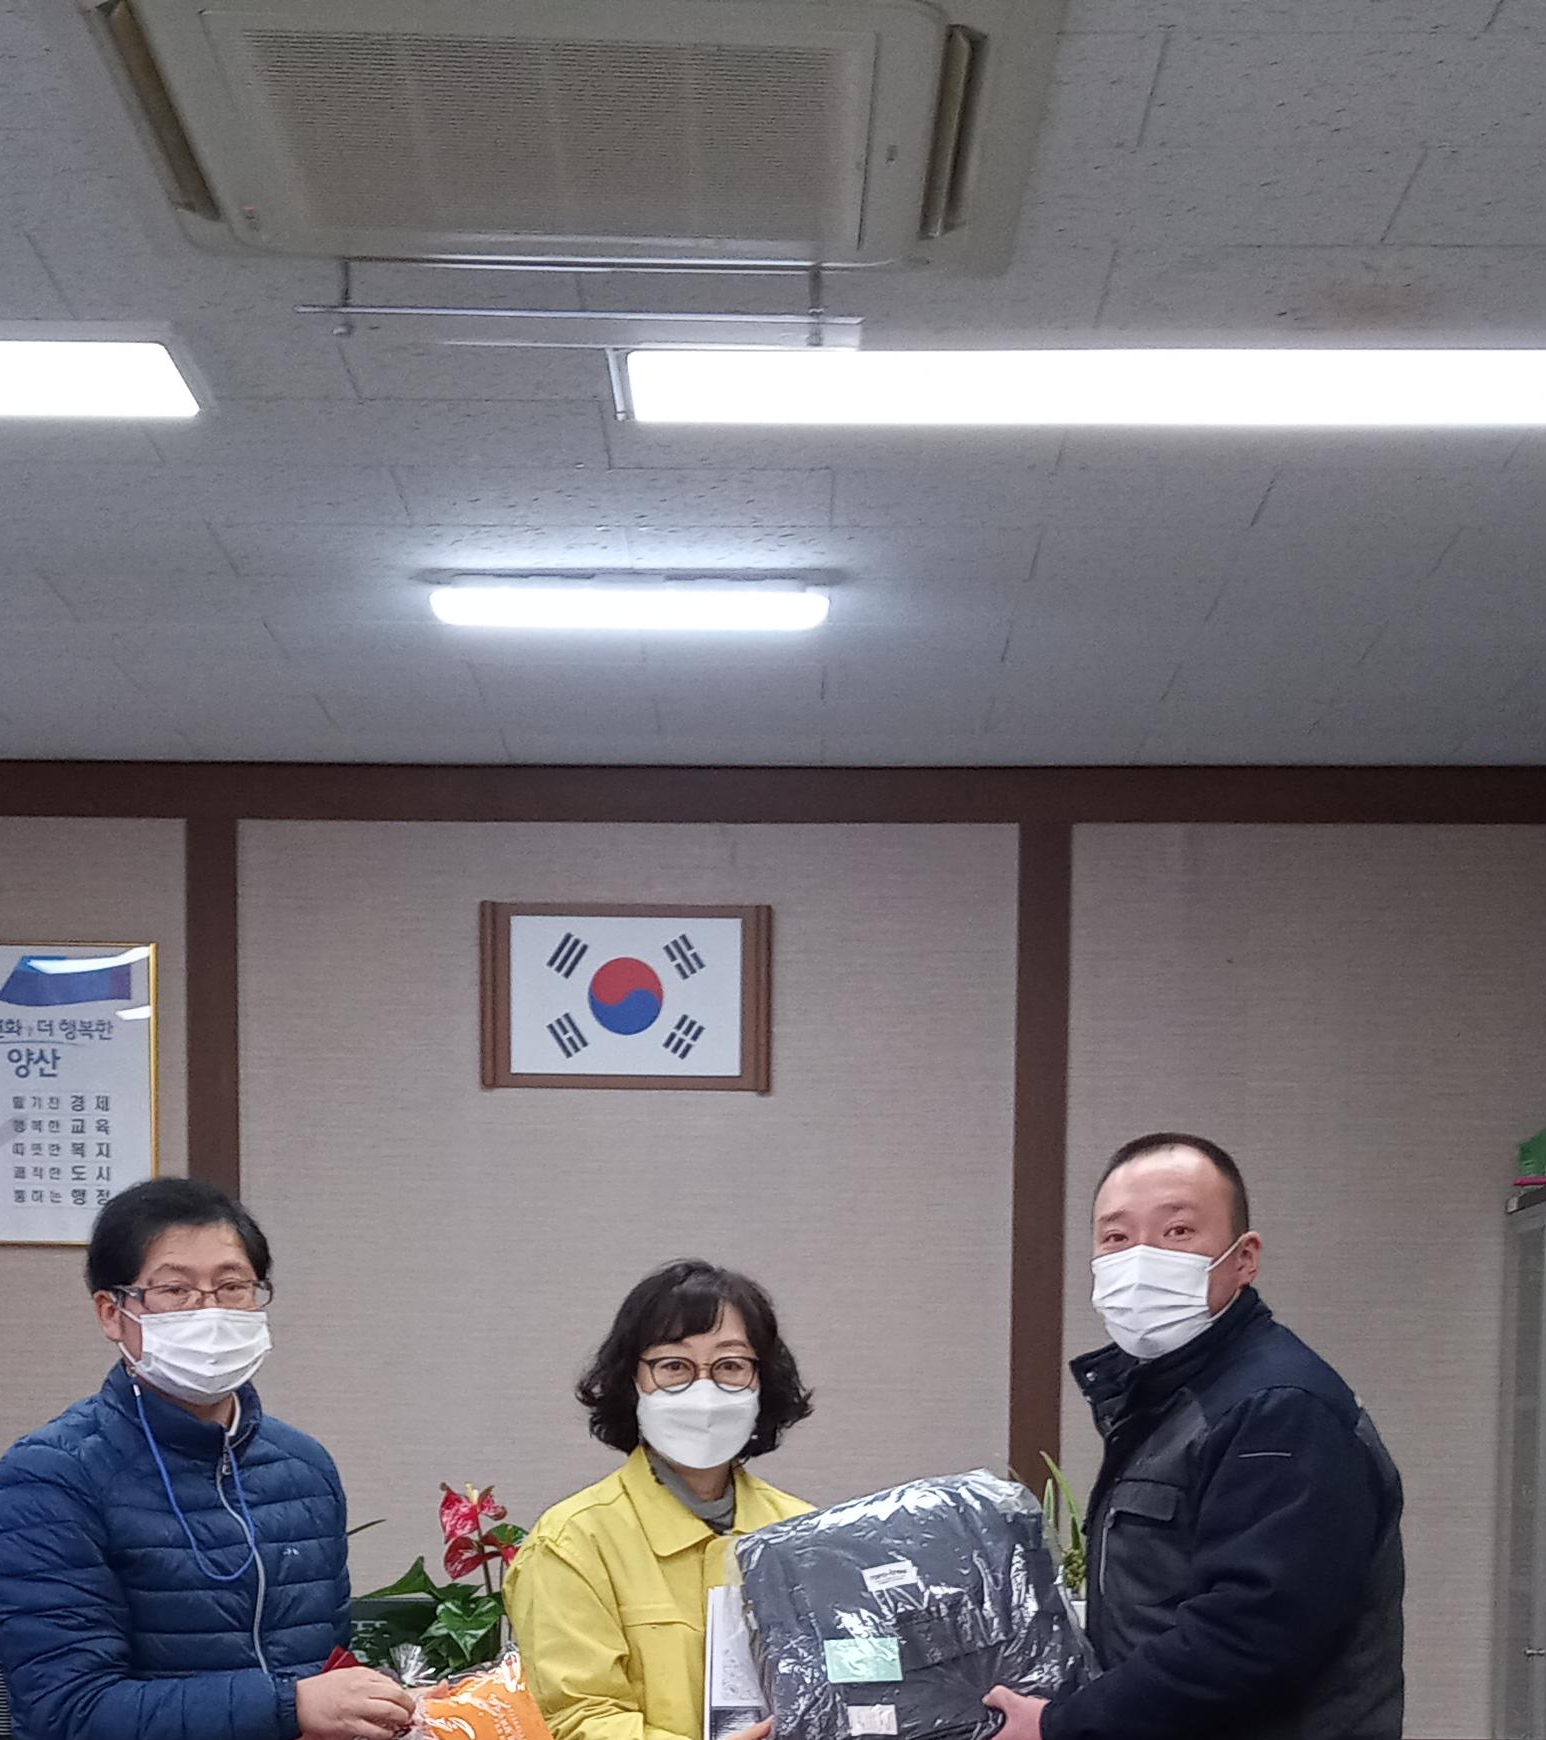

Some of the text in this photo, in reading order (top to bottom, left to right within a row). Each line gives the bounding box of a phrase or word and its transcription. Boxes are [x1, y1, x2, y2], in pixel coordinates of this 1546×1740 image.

[36, 1018, 53, 1037] 더
[59, 1018, 115, 1041] 행복한
[6, 1047, 61, 1079] 양산
[70, 1095, 110, 1112] 경제
[70, 1118, 110, 1135] 교육
[70, 1142, 111, 1158] 복지
[71, 1165, 111, 1181] 도시
